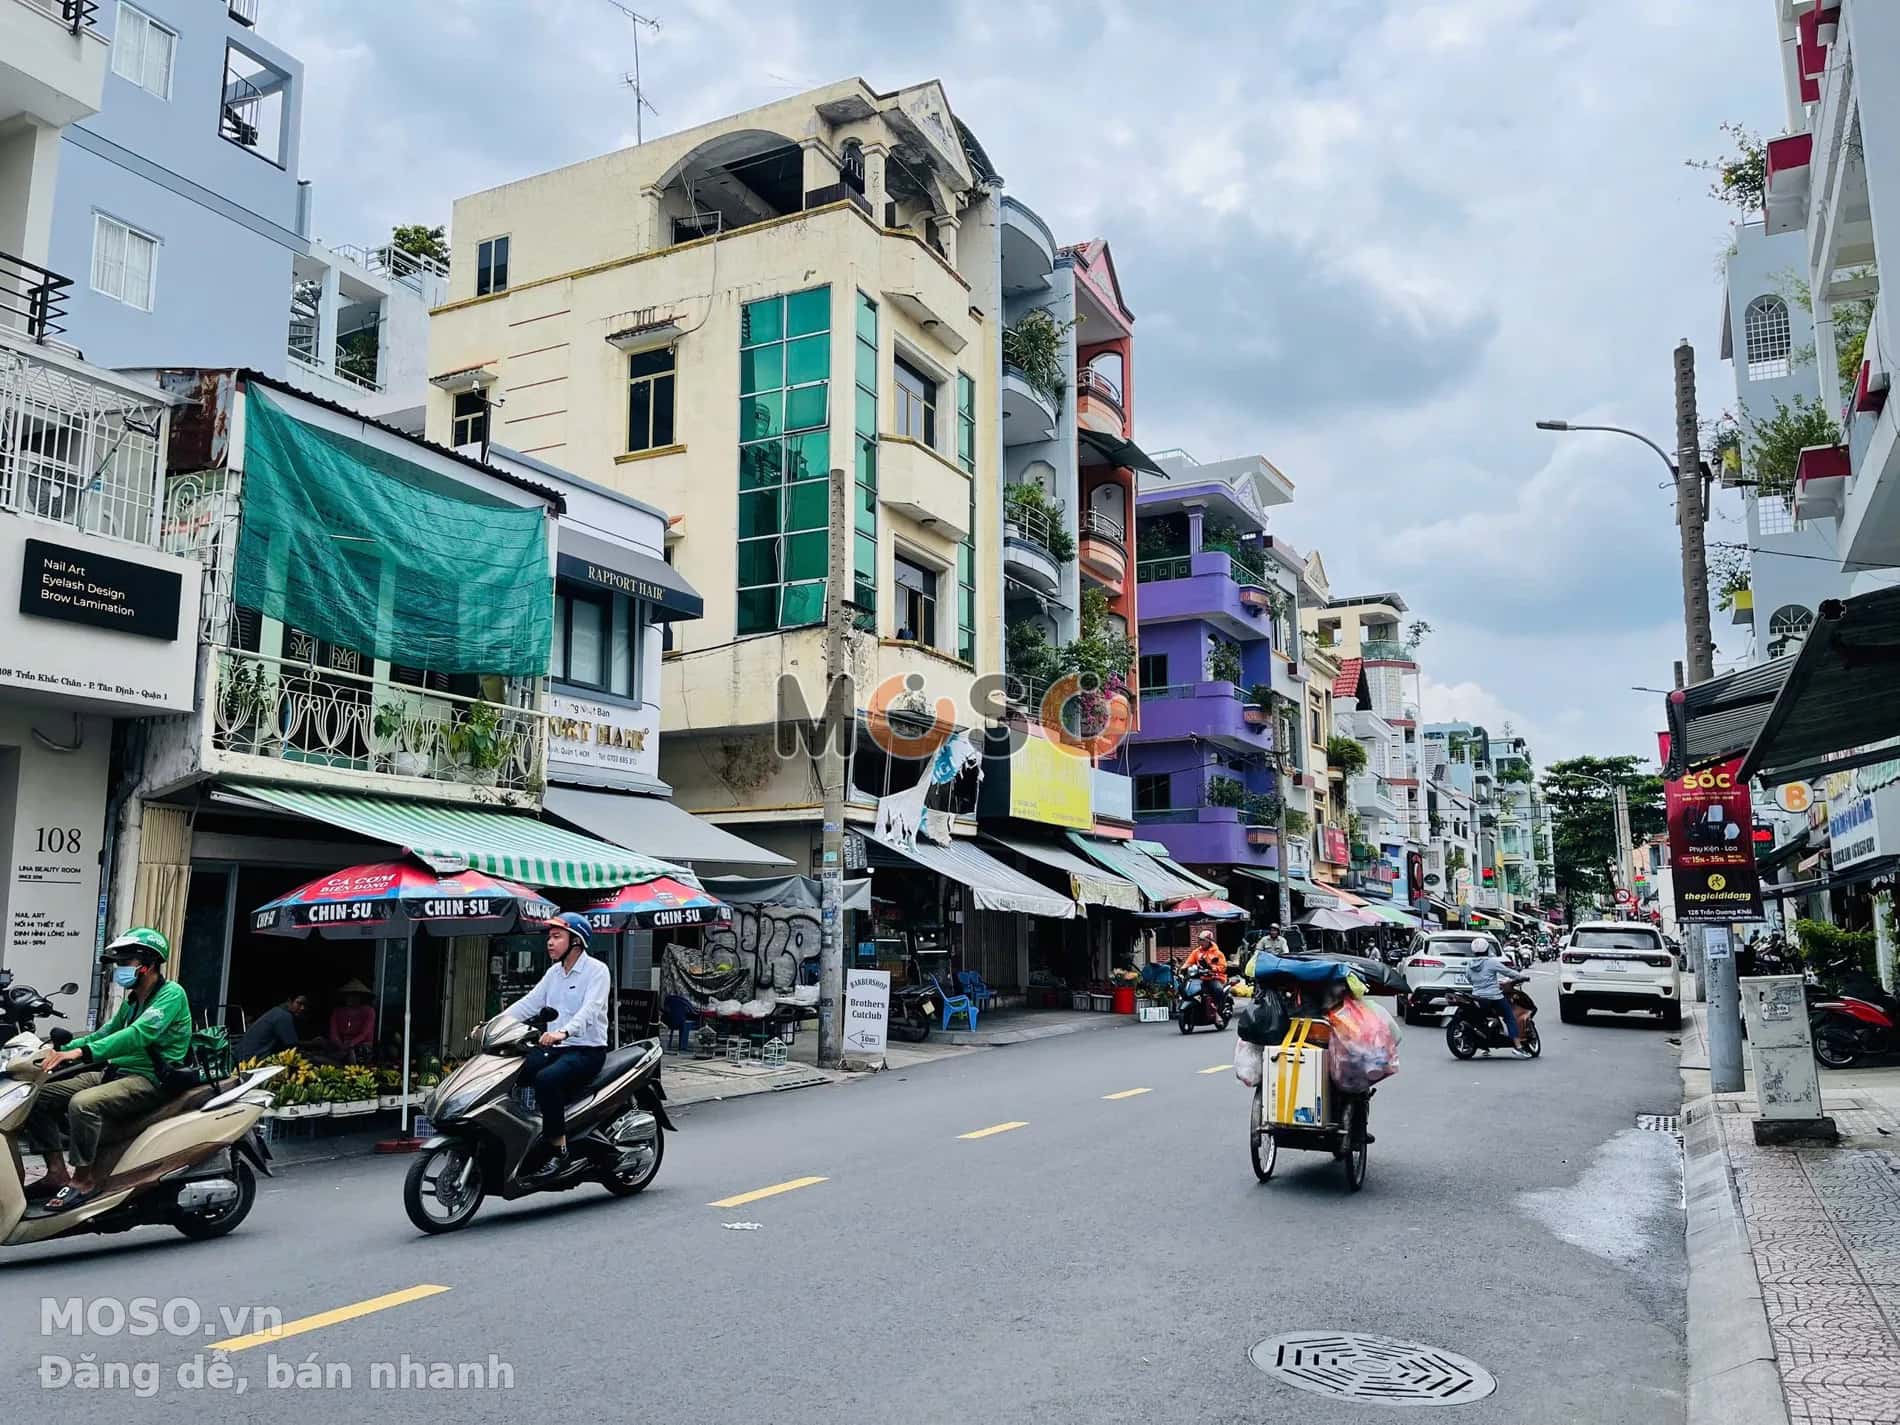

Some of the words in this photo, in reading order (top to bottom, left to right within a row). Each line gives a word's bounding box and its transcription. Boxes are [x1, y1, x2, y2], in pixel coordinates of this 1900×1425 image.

[44, 558, 66, 571] Nail
[68, 564, 86, 577] Art
[42, 573, 85, 592] Eyelash
[88, 583, 126, 601] Design
[588, 565, 638, 593] RAPPORT
[639, 582, 664, 601] HAIR
[41, 589, 71, 604] Brow
[73, 594, 135, 617] Lamination
[596, 723, 645, 751] HAIR
[35, 827, 82, 854] 108
[35, 865, 59, 873] BEAUTY
[1684, 892, 1751, 902] thegioididong
[309, 902, 372, 921] CHIN-SU
[424, 899, 489, 916] CHIN-SU
[653, 909, 700, 925] CHIN-SU
[850, 978, 888, 990] BARBERSHOP
[850, 998, 885, 1008] Brothers
[852, 1009, 882, 1020] Cutclub
